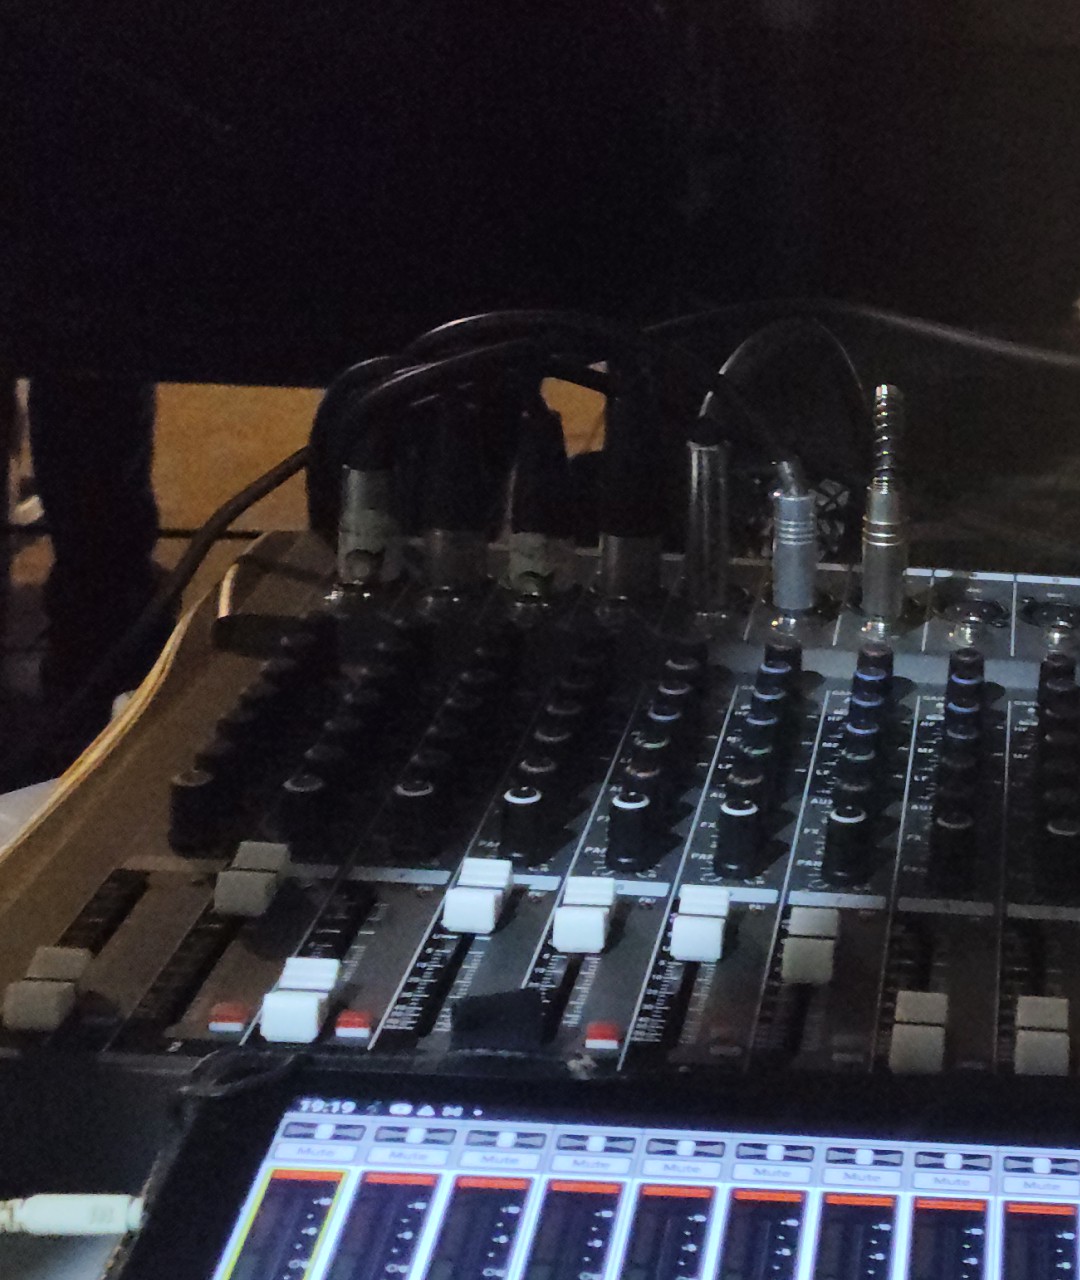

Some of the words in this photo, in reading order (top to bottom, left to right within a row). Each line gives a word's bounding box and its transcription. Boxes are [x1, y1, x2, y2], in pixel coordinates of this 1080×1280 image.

[297, 1145, 335, 1158] Mute
[390, 1150, 428, 1162] Mute
[481, 1154, 519, 1165] Mute
[572, 1159, 611, 1170] Mute
[663, 1163, 702, 1175] Mute
[753, 1167, 791, 1179] Mute
[843, 1171, 881, 1184] Mute
[933, 1176, 970, 1188] Mute
[1023, 1180, 1060, 1192] Mute
